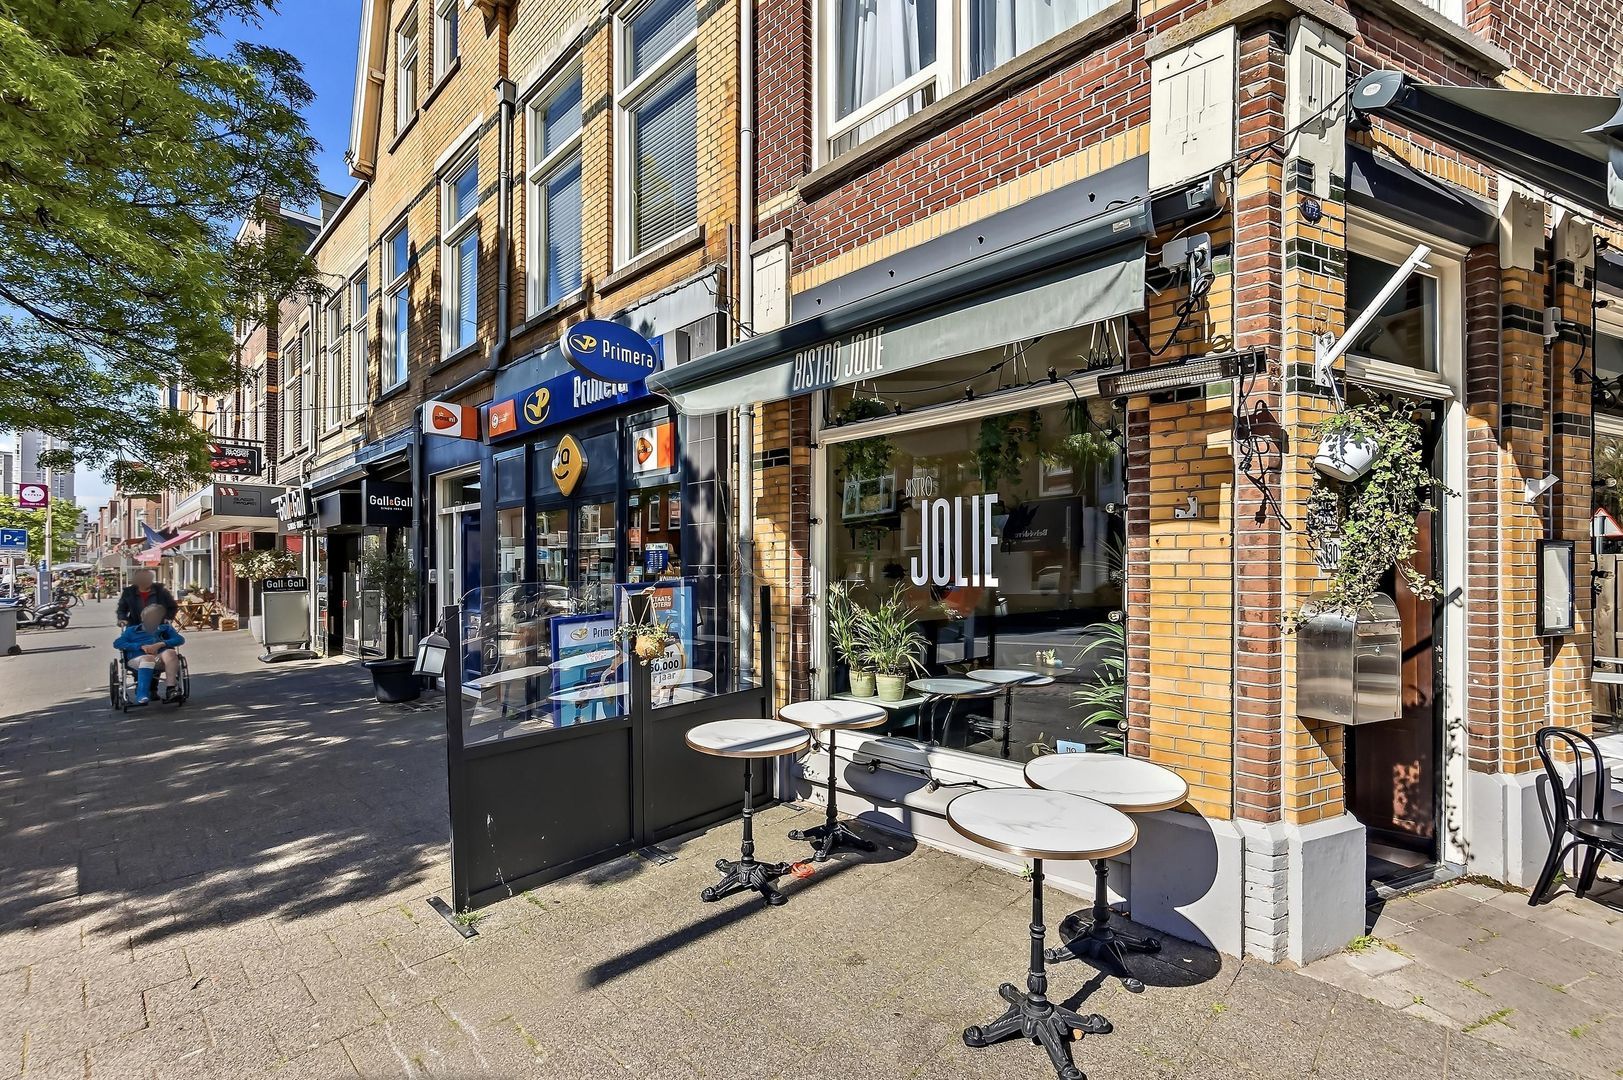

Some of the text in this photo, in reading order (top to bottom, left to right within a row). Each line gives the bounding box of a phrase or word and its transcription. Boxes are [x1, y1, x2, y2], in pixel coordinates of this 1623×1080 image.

[602, 339, 653, 368] Primera
[793, 326, 885, 391] BISTRO JOLIE
[905, 475, 933, 498] BISTRO
[369, 494, 413, 508] Gall&Gall
[3, 534, 12, 543] P
[910, 493, 999, 588] JOLIE
[593, 627, 614, 638] Prime
[658, 672, 676, 684] jaar
